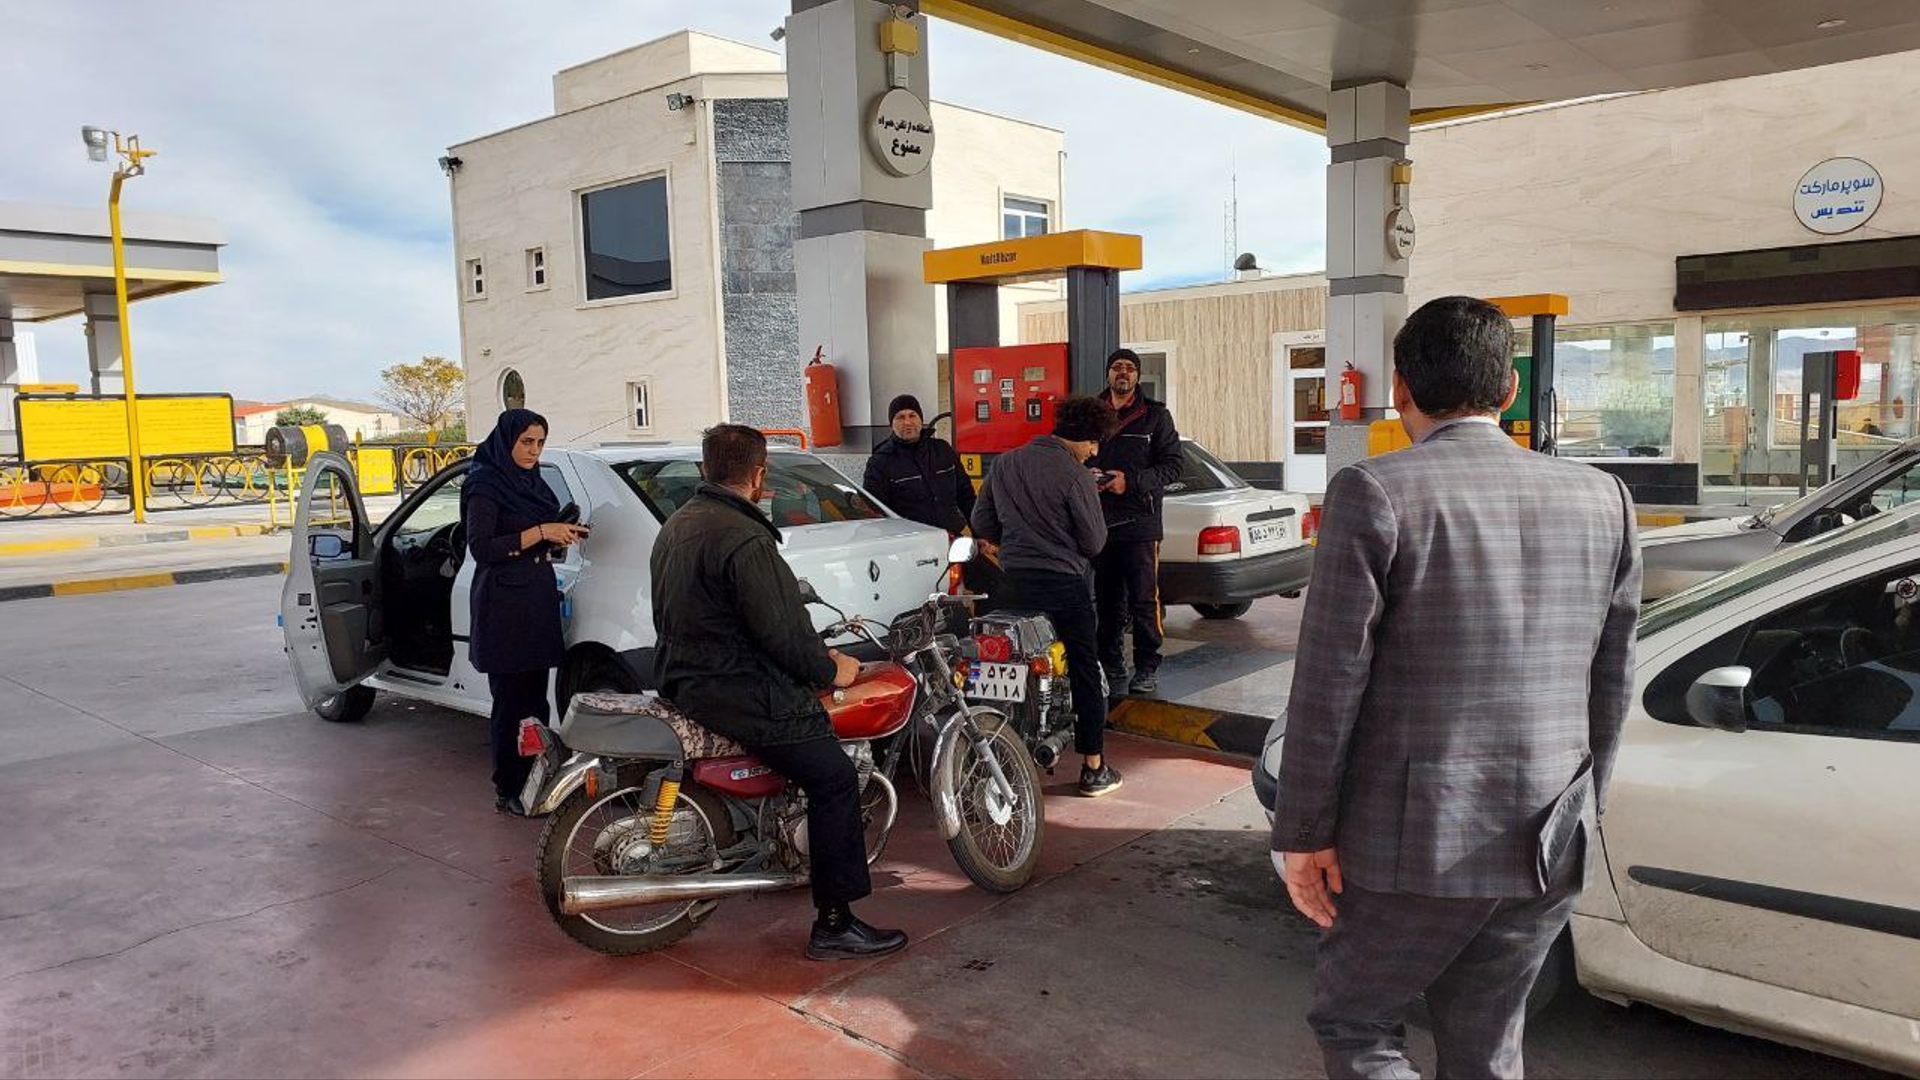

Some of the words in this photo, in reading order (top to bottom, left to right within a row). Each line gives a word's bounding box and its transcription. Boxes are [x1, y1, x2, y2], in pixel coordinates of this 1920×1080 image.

[891, 138, 922, 157] ممنوع
[1811, 200, 1866, 219] تندیس
[967, 458, 974, 471] 8
[987, 665, 1017, 680] ۵۳۵
[973, 682, 1020, 698] ۱۷۱۱۸
